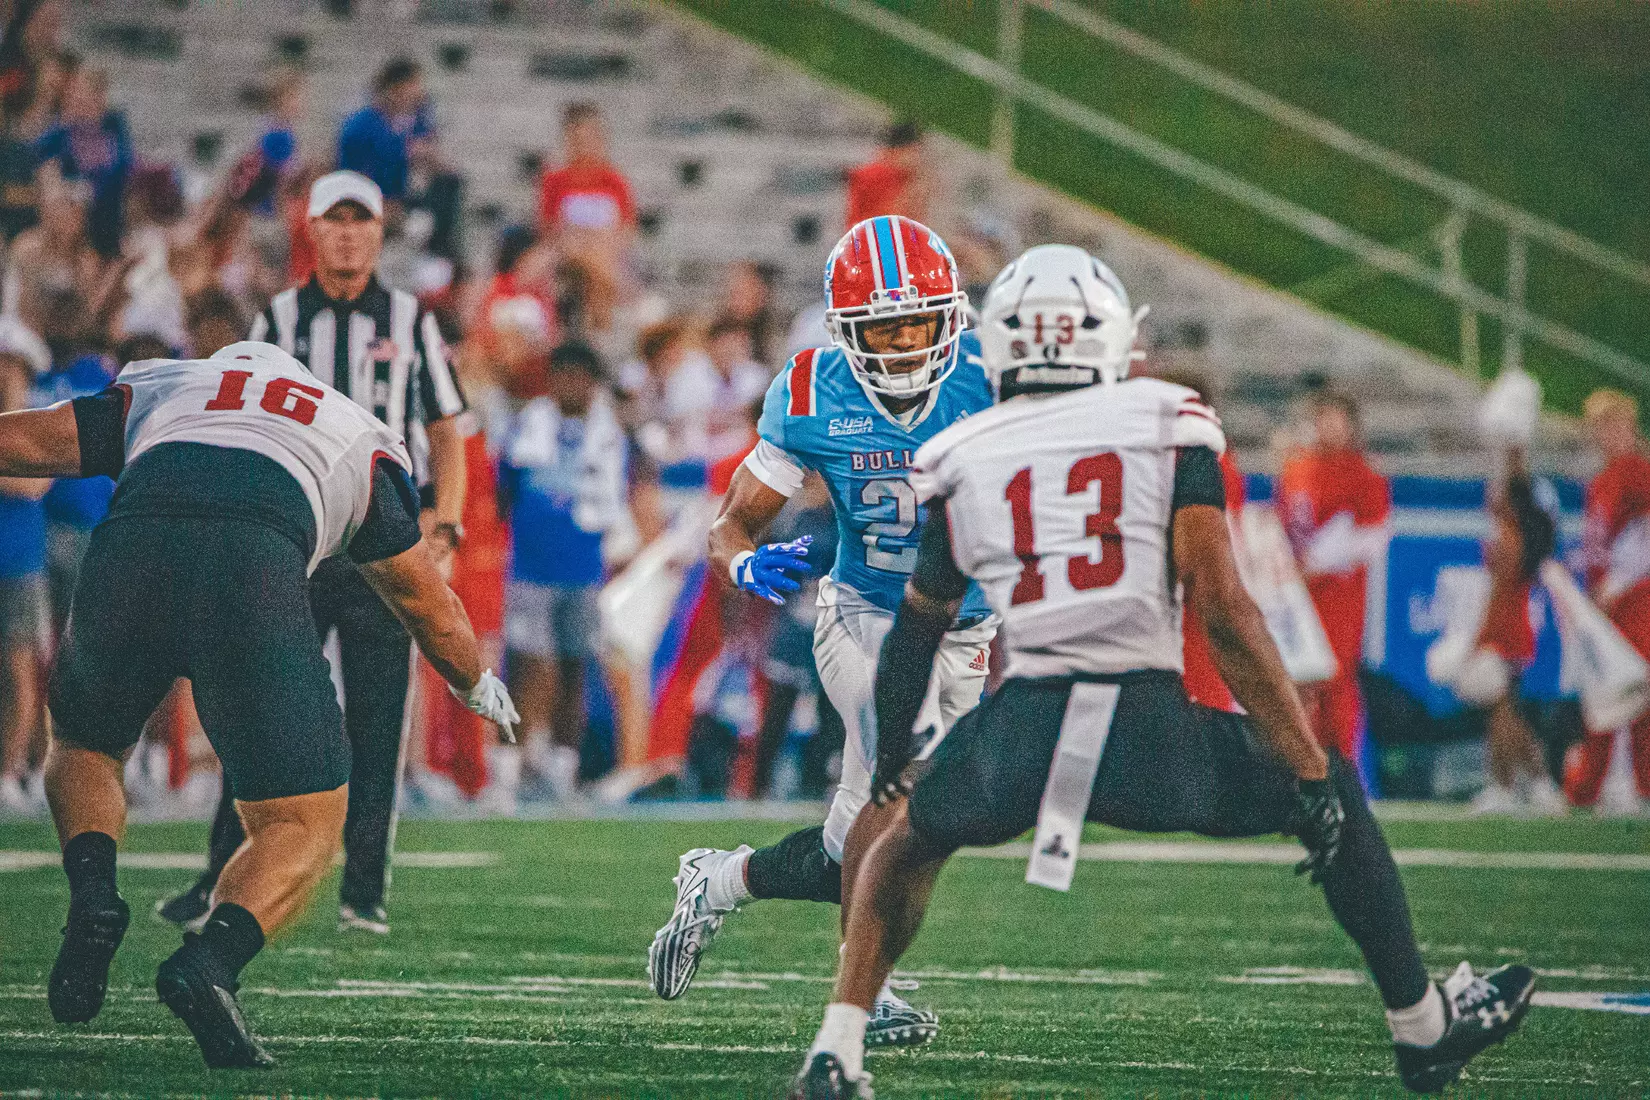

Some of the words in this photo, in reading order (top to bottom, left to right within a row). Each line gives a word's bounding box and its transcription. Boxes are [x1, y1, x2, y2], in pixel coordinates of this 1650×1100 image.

[1034, 313, 1074, 344] 13
[204, 370, 325, 426] 16
[861, 478, 918, 574] 2
[1005, 452, 1124, 606] 13
